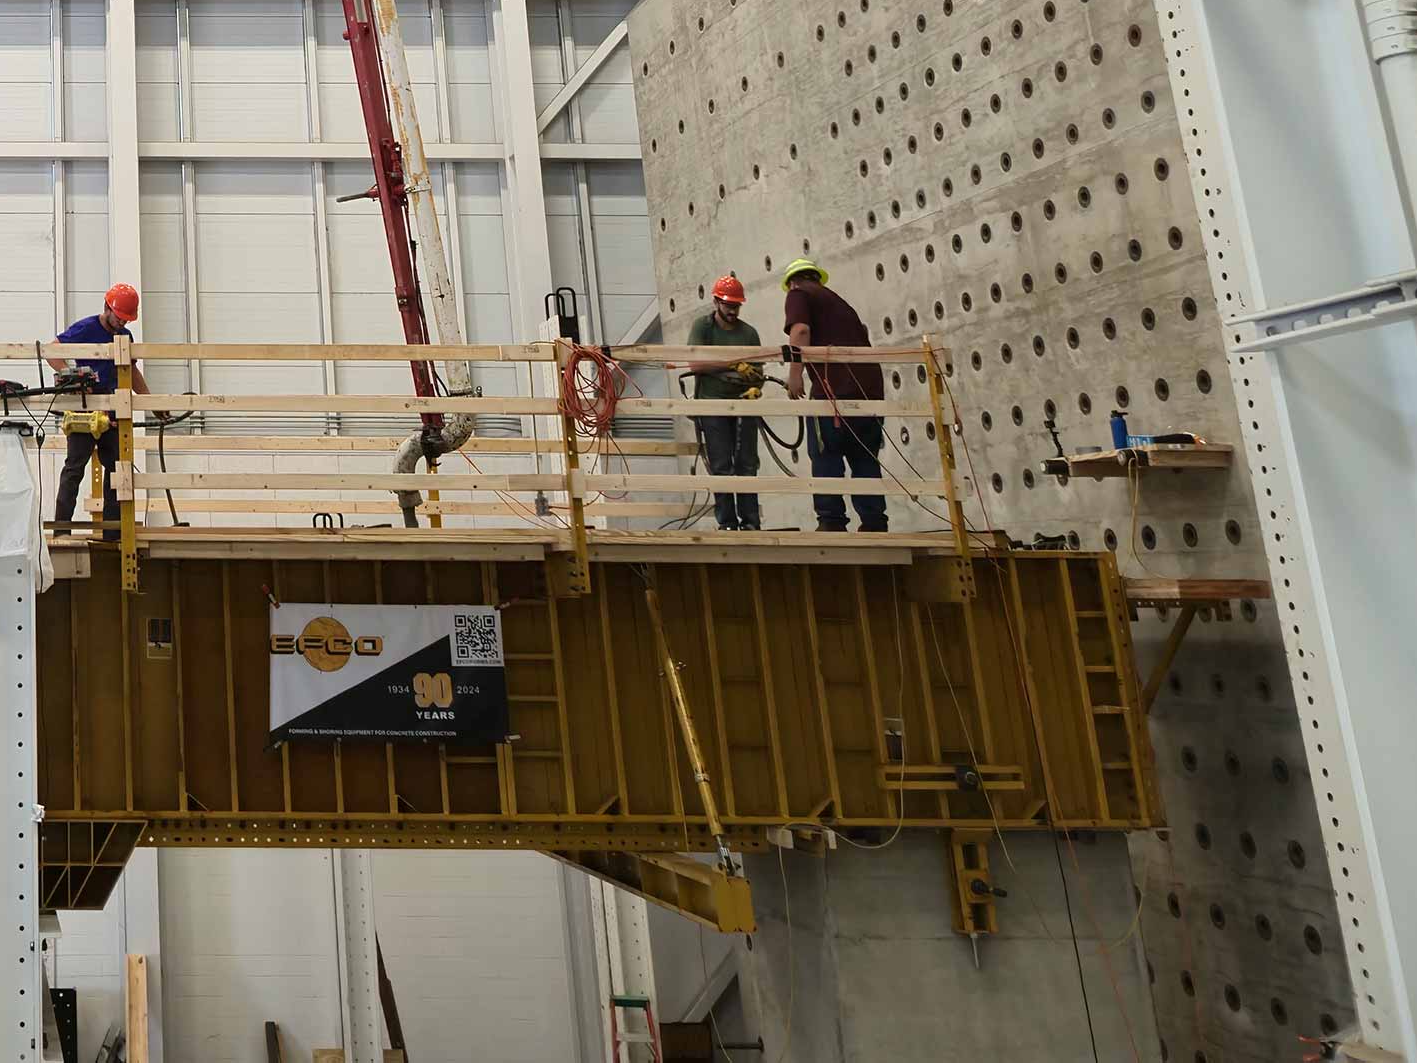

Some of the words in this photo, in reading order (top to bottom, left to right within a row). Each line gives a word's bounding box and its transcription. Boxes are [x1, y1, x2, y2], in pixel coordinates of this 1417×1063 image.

[270, 634, 384, 656] EFCO
[387, 685, 410, 694] 1934
[413, 672, 453, 708] 90
[456, 685, 480, 695] 2024
[415, 711, 456, 721] YEARS
